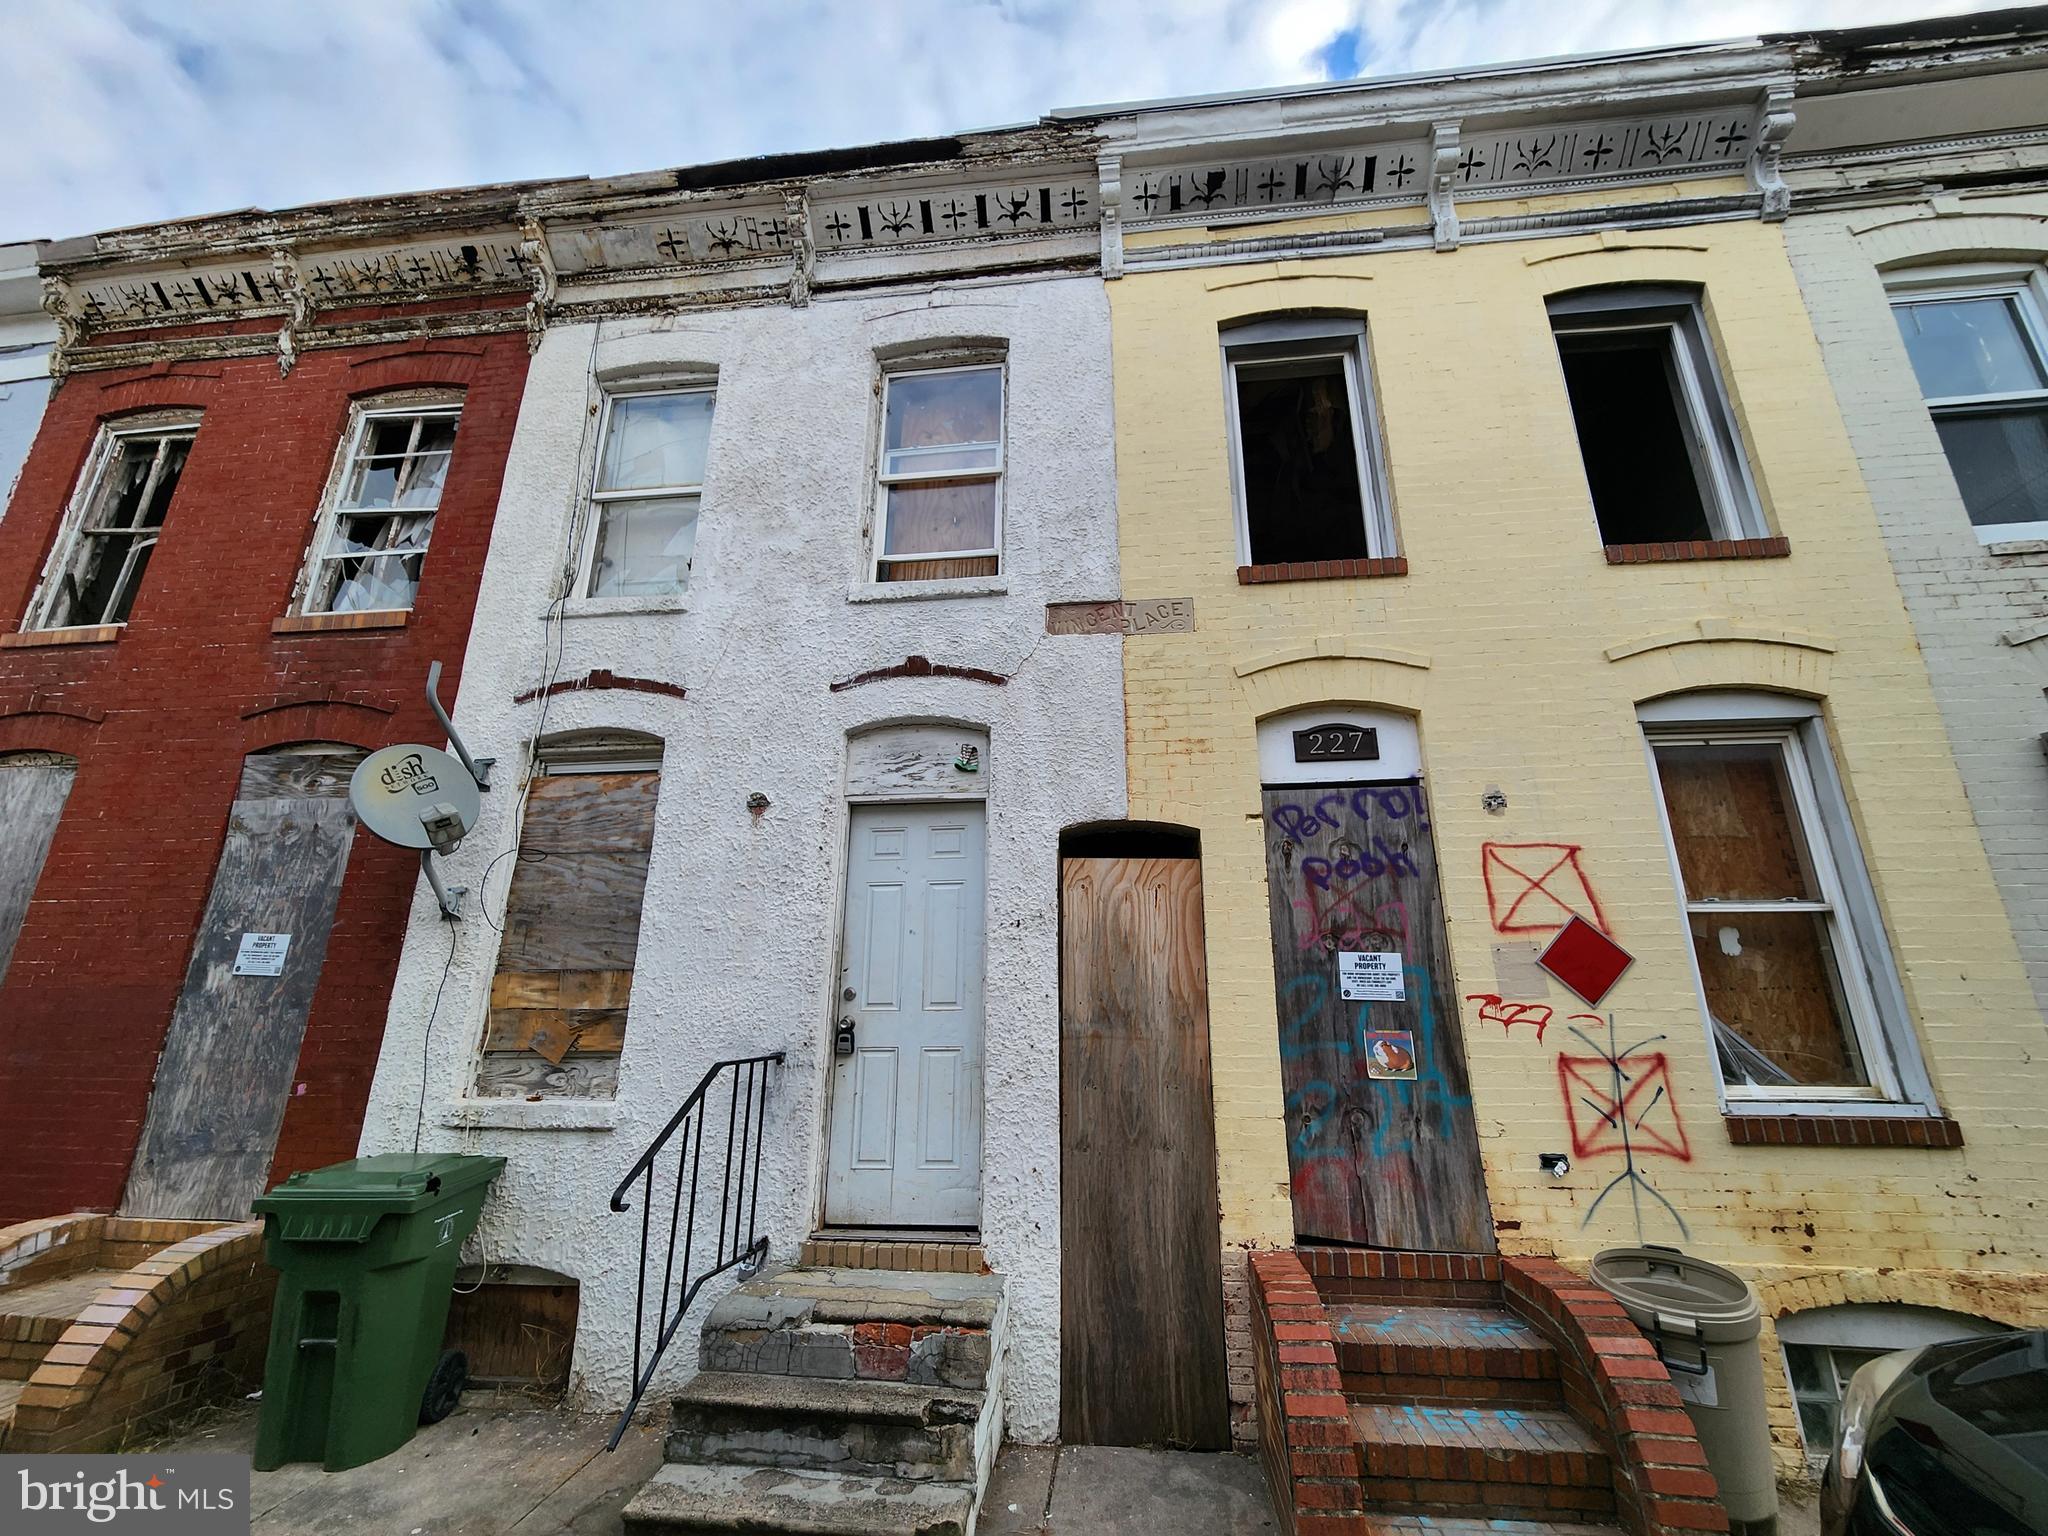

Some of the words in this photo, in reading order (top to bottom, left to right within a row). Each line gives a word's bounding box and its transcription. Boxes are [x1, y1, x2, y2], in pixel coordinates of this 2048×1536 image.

[1309, 731, 1363, 754] 227
[381, 760, 426, 785] dish
[1357, 954, 1382, 962] VACANT
[1354, 962, 1386, 970] PROPERTY
